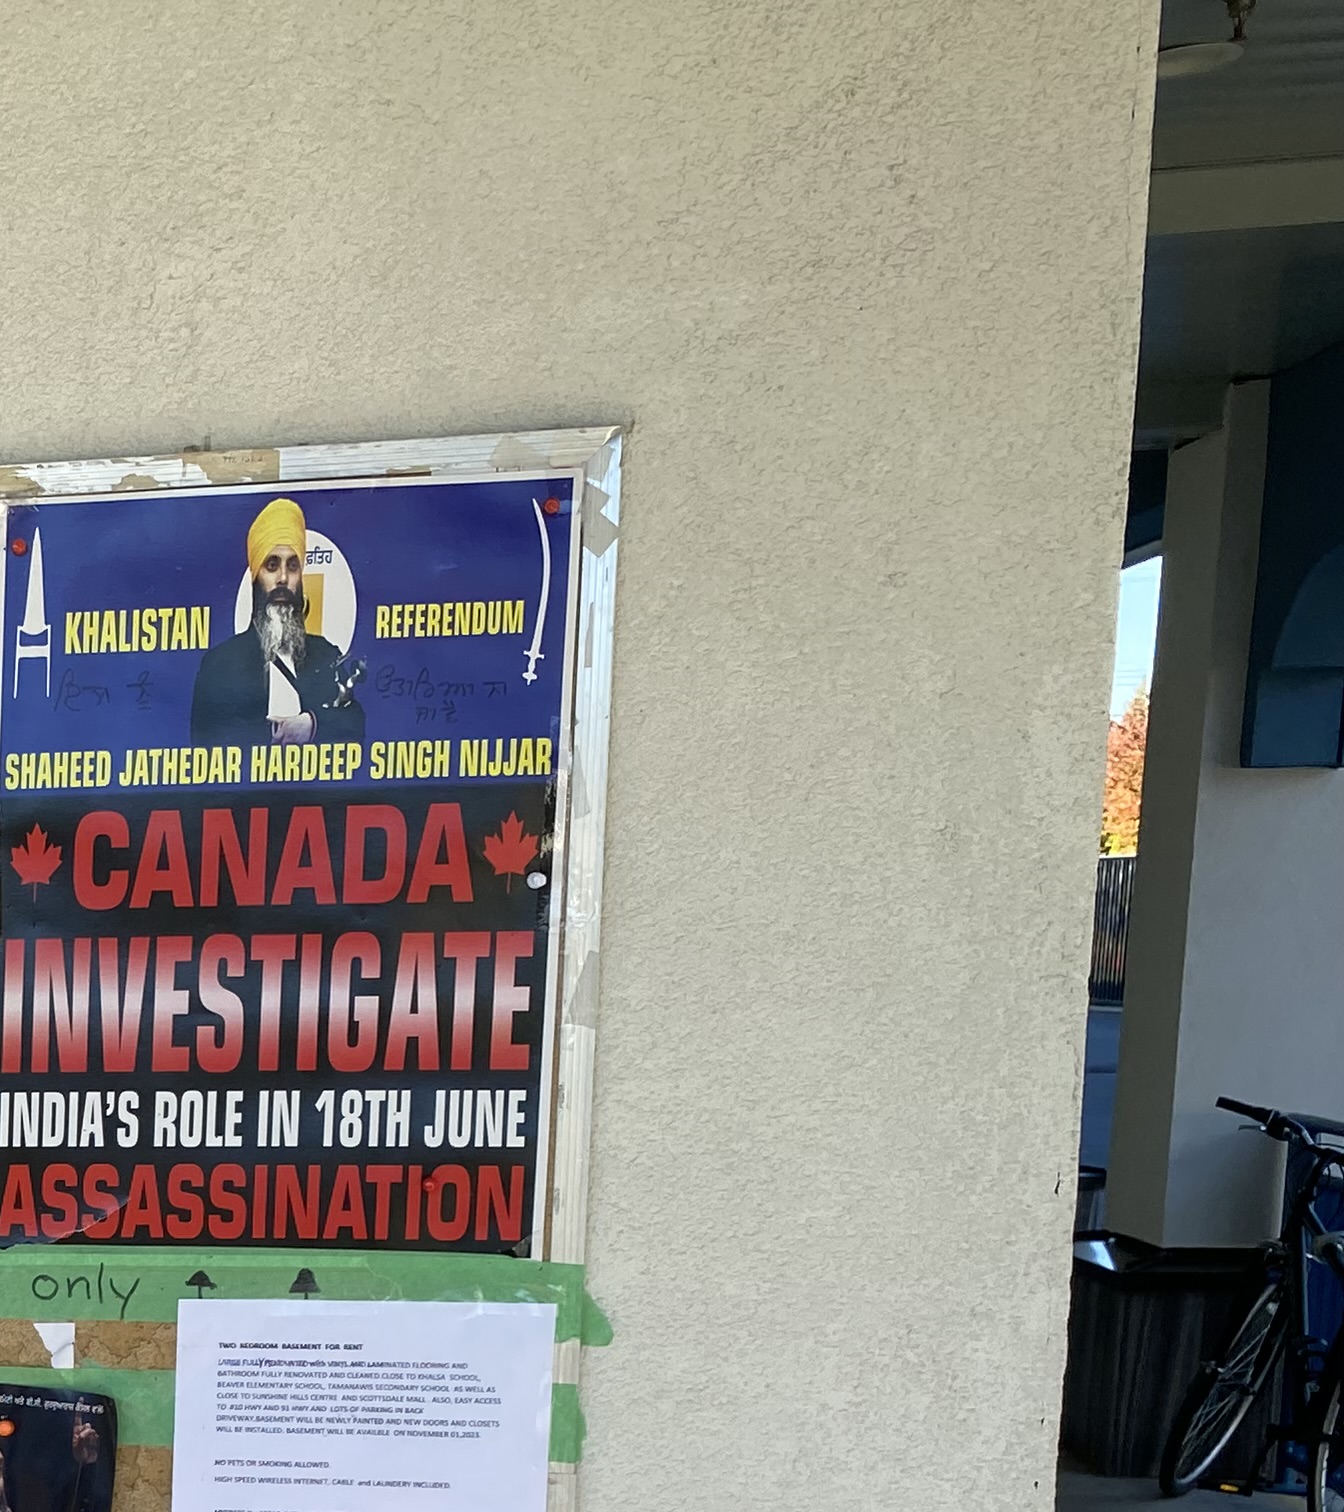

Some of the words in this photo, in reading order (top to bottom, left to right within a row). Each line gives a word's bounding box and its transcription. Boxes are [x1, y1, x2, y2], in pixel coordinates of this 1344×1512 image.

[64, 607, 210, 654] KHALISTAN
[374, 600, 524, 639] REFERENDUM
[5, 748, 112, 790] SHAHEED
[119, 745, 241, 785] JATHEDAR
[250, 742, 361, 782] HARDEEP
[370, 739, 449, 778] SINGH
[459, 738, 551, 777] NIJJAR
[72, 803, 474, 910] CANADA
[0, 930, 535, 1074] INVESTIGATE
[152, 1090, 244, 1147] ROLE
[257, 1089, 300, 1147] IN
[314, 1088, 411, 1147] 18TH
[423, 1088, 527, 1148] JUNE
[31, 1262, 141, 1319] only
